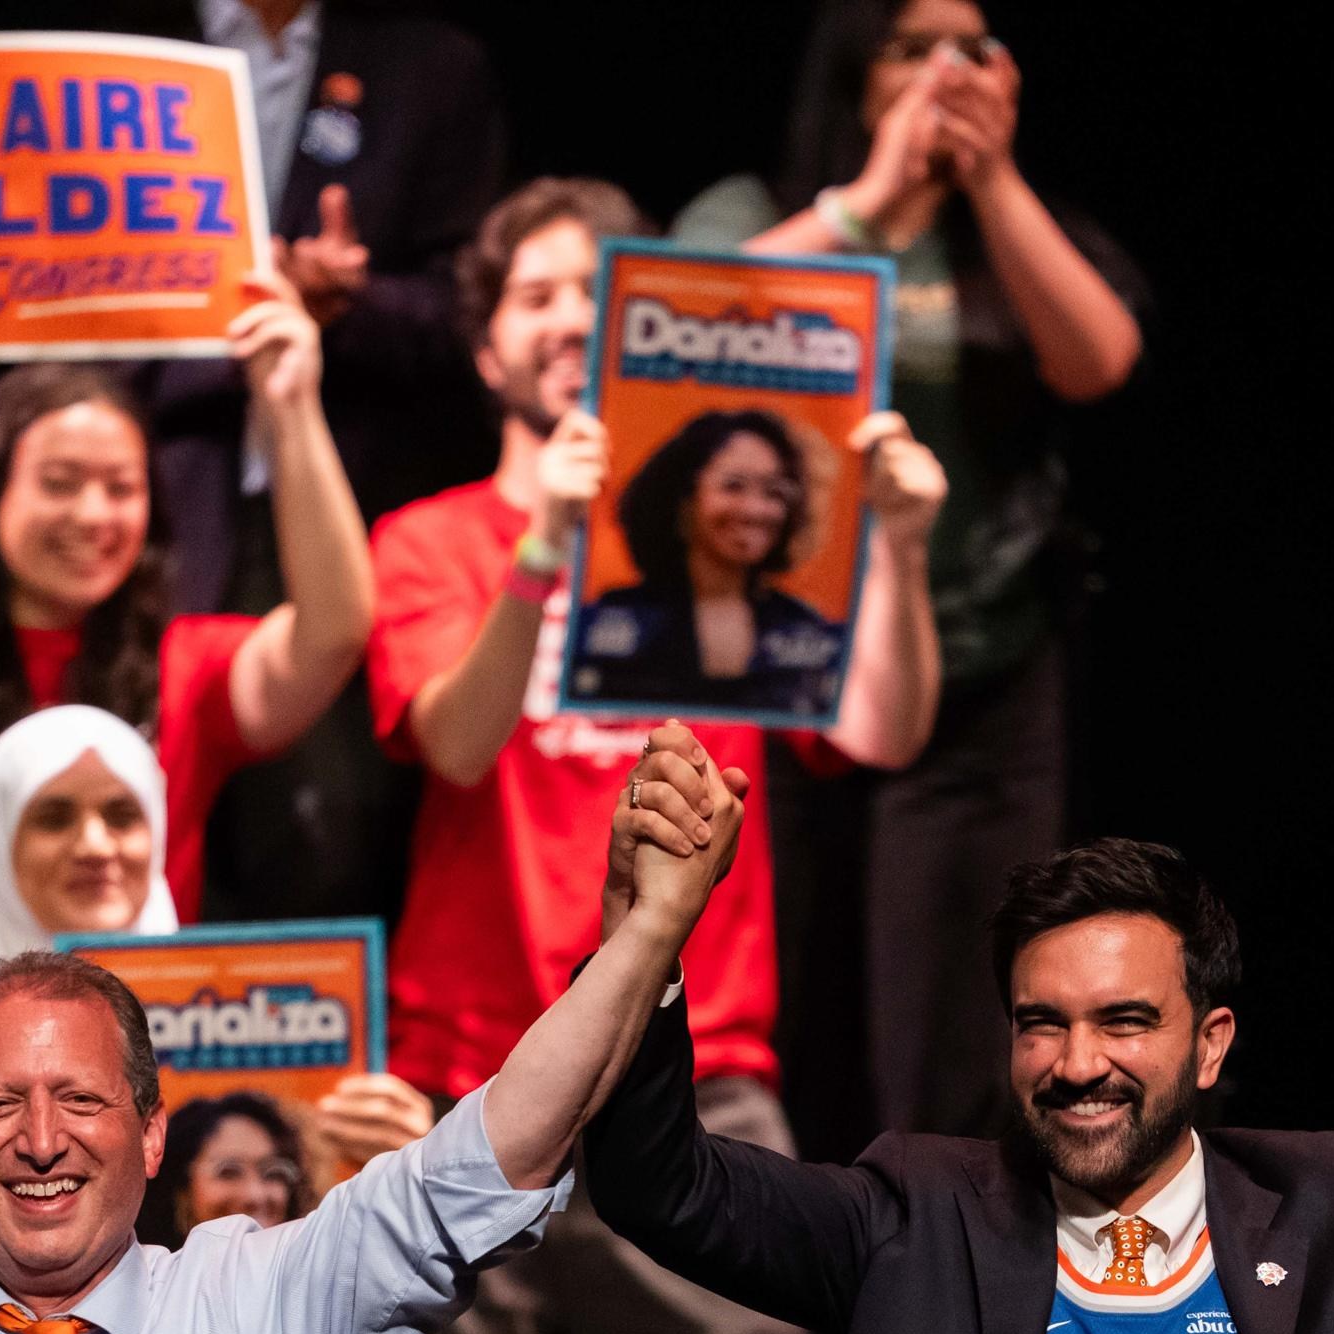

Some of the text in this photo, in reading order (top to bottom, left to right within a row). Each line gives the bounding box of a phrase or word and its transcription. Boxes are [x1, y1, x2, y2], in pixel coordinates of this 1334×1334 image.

[147, 987, 346, 1048] arializa
[1186, 1310, 1231, 1319] experienc
[1186, 1319, 1225, 1334] abu
